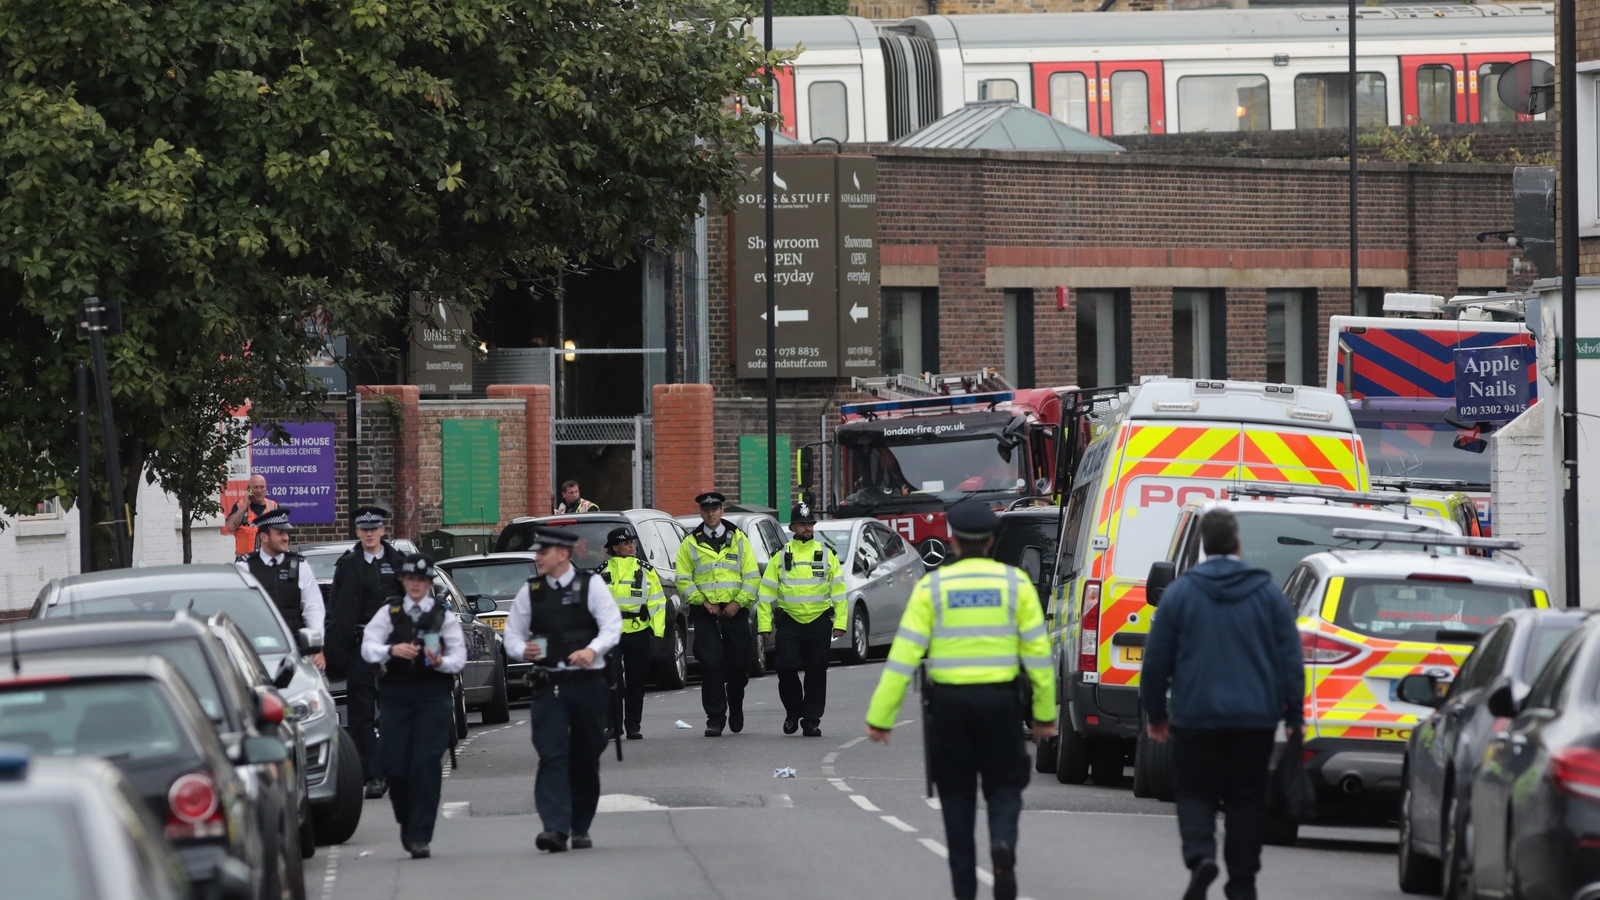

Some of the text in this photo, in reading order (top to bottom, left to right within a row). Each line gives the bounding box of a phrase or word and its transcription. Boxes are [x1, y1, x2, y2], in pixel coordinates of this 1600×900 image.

[738, 193, 830, 204] SOFS&STUFF
[844, 235, 873, 248] Showroom
[764, 252, 803, 266] PEN
[850, 252, 867, 265] OPEN
[754, 268, 814, 286] evryday
[847, 268, 871, 285] everyday
[779, 347, 796, 357] 078
[797, 347, 820, 357] 8835
[747, 358, 828, 369] sofandstuff.com
[1463, 355, 1520, 377] Apple
[1468, 380, 1517, 398] Nails
[1460, 404, 1526, 416] 020 3302 9415
[883, 421, 965, 437] london-fire.gov.uk
[301, 437, 330, 446] HOUSE
[298, 447, 321, 455] CENTRE
[286, 465, 317, 473] OFFICES
[272, 486, 287, 496] 020
[289, 486, 309, 495] 7384
[310, 485, 330, 495] 0177
[949, 593, 1000, 607] POLICE
